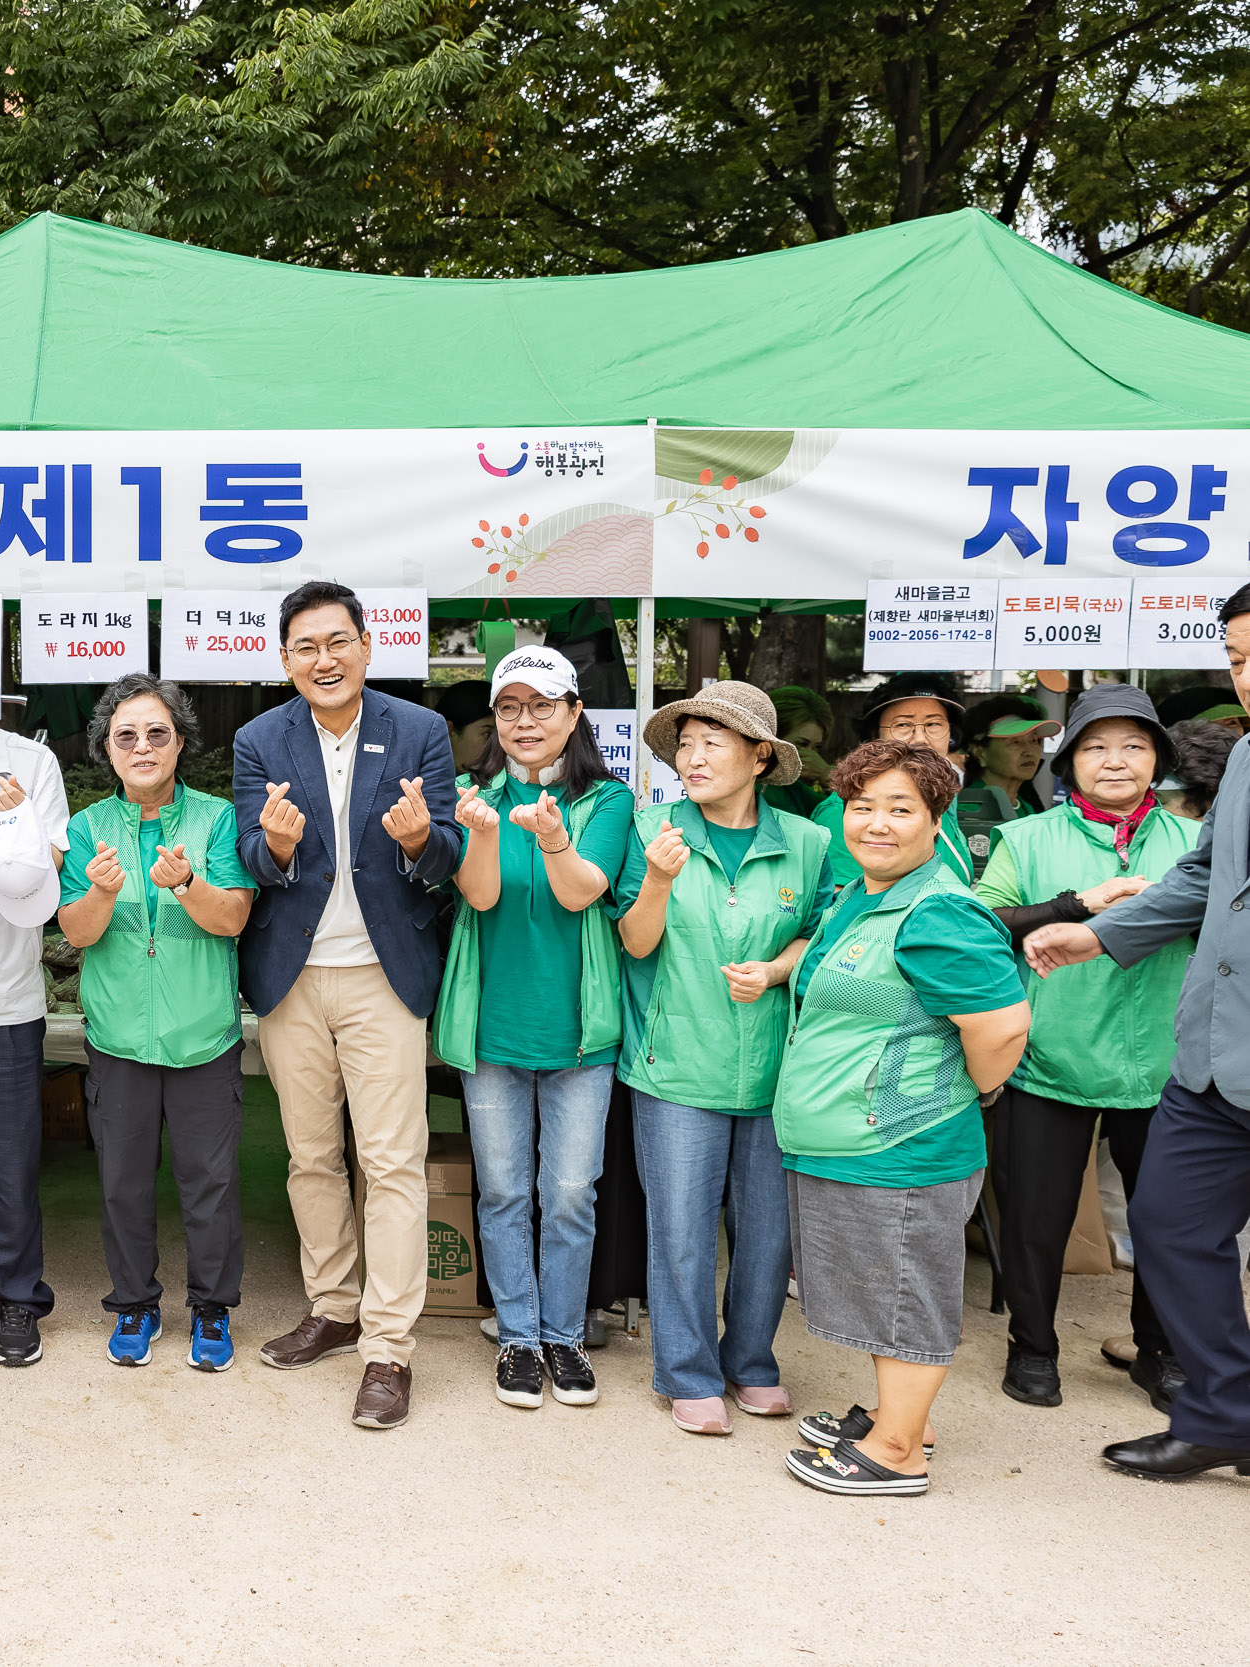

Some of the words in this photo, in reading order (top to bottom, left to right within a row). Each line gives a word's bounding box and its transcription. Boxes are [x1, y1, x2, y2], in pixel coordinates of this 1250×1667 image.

[534, 440, 568, 455] 소통하며
[569, 440, 604, 455] 발전하는
[534, 453, 604, 478] 행복광진
[963, 464, 1250, 567] 자양
[894, 585, 971, 601] 새마을금고
[1003, 596, 1123, 613] 도토리묵(국산)
[104, 612, 132, 628] 1kg
[238, 610, 266, 627] 1kg
[917, 608, 994, 622] 새마을부녀회)
[379, 631, 421, 648] 5,000
[868, 629, 992, 641] 9002-2056-1742-8
[1024, 624, 1101, 645] 5,000원
[67, 640, 126, 660] 16,000
[206, 635, 266, 655] 25,000
[498, 656, 556, 679] Titleist
[600, 745, 631, 761] 라지
